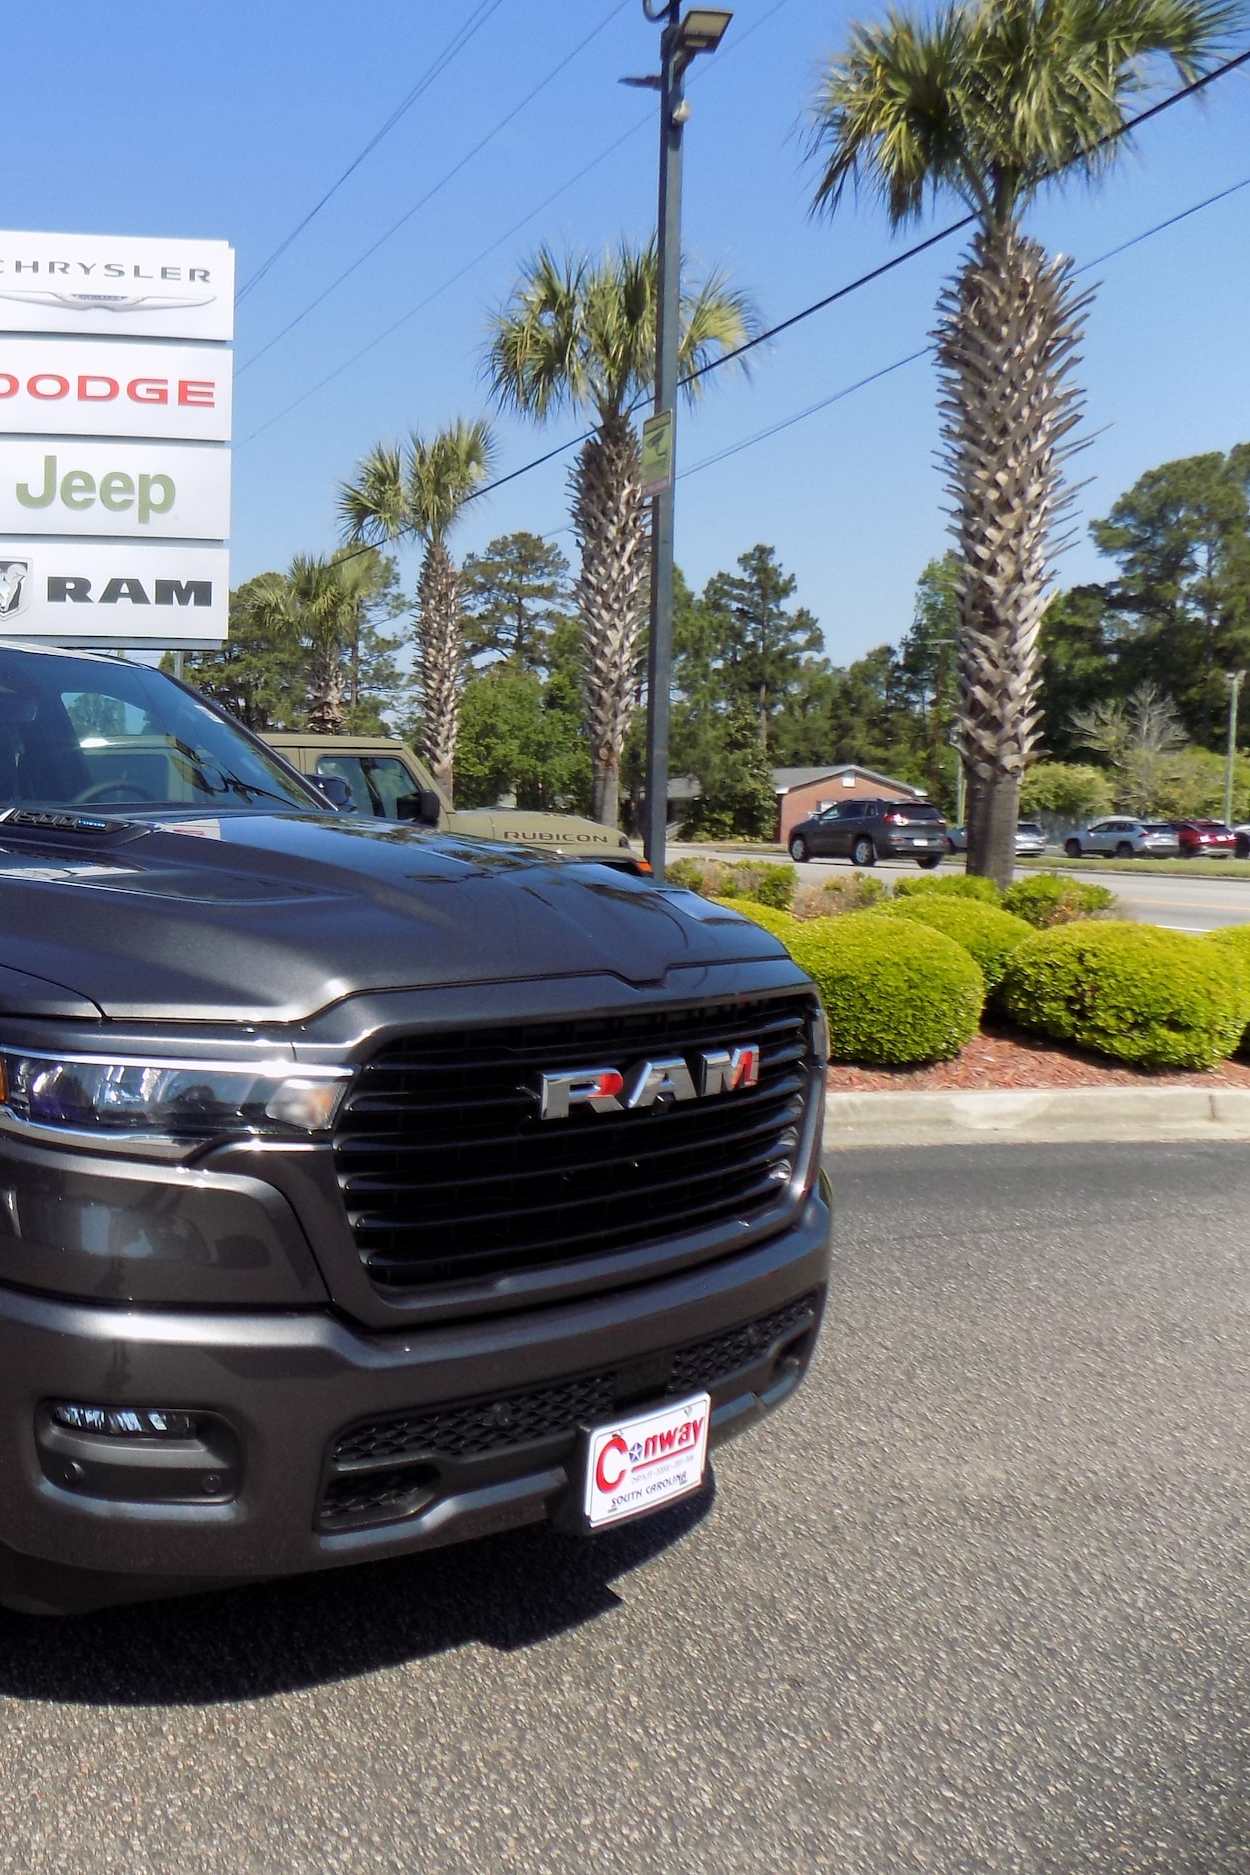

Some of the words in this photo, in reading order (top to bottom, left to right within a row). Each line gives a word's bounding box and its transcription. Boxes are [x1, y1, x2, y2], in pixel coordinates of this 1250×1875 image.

[15, 455, 176, 524] Jeep
[46, 575, 213, 608] RAM
[503, 831, 608, 843] RUBICON
[540, 1042, 760, 1120] RAM
[611, 1488, 643, 1508] SOUTH
[645, 1470, 687, 1496] CAROLINA
